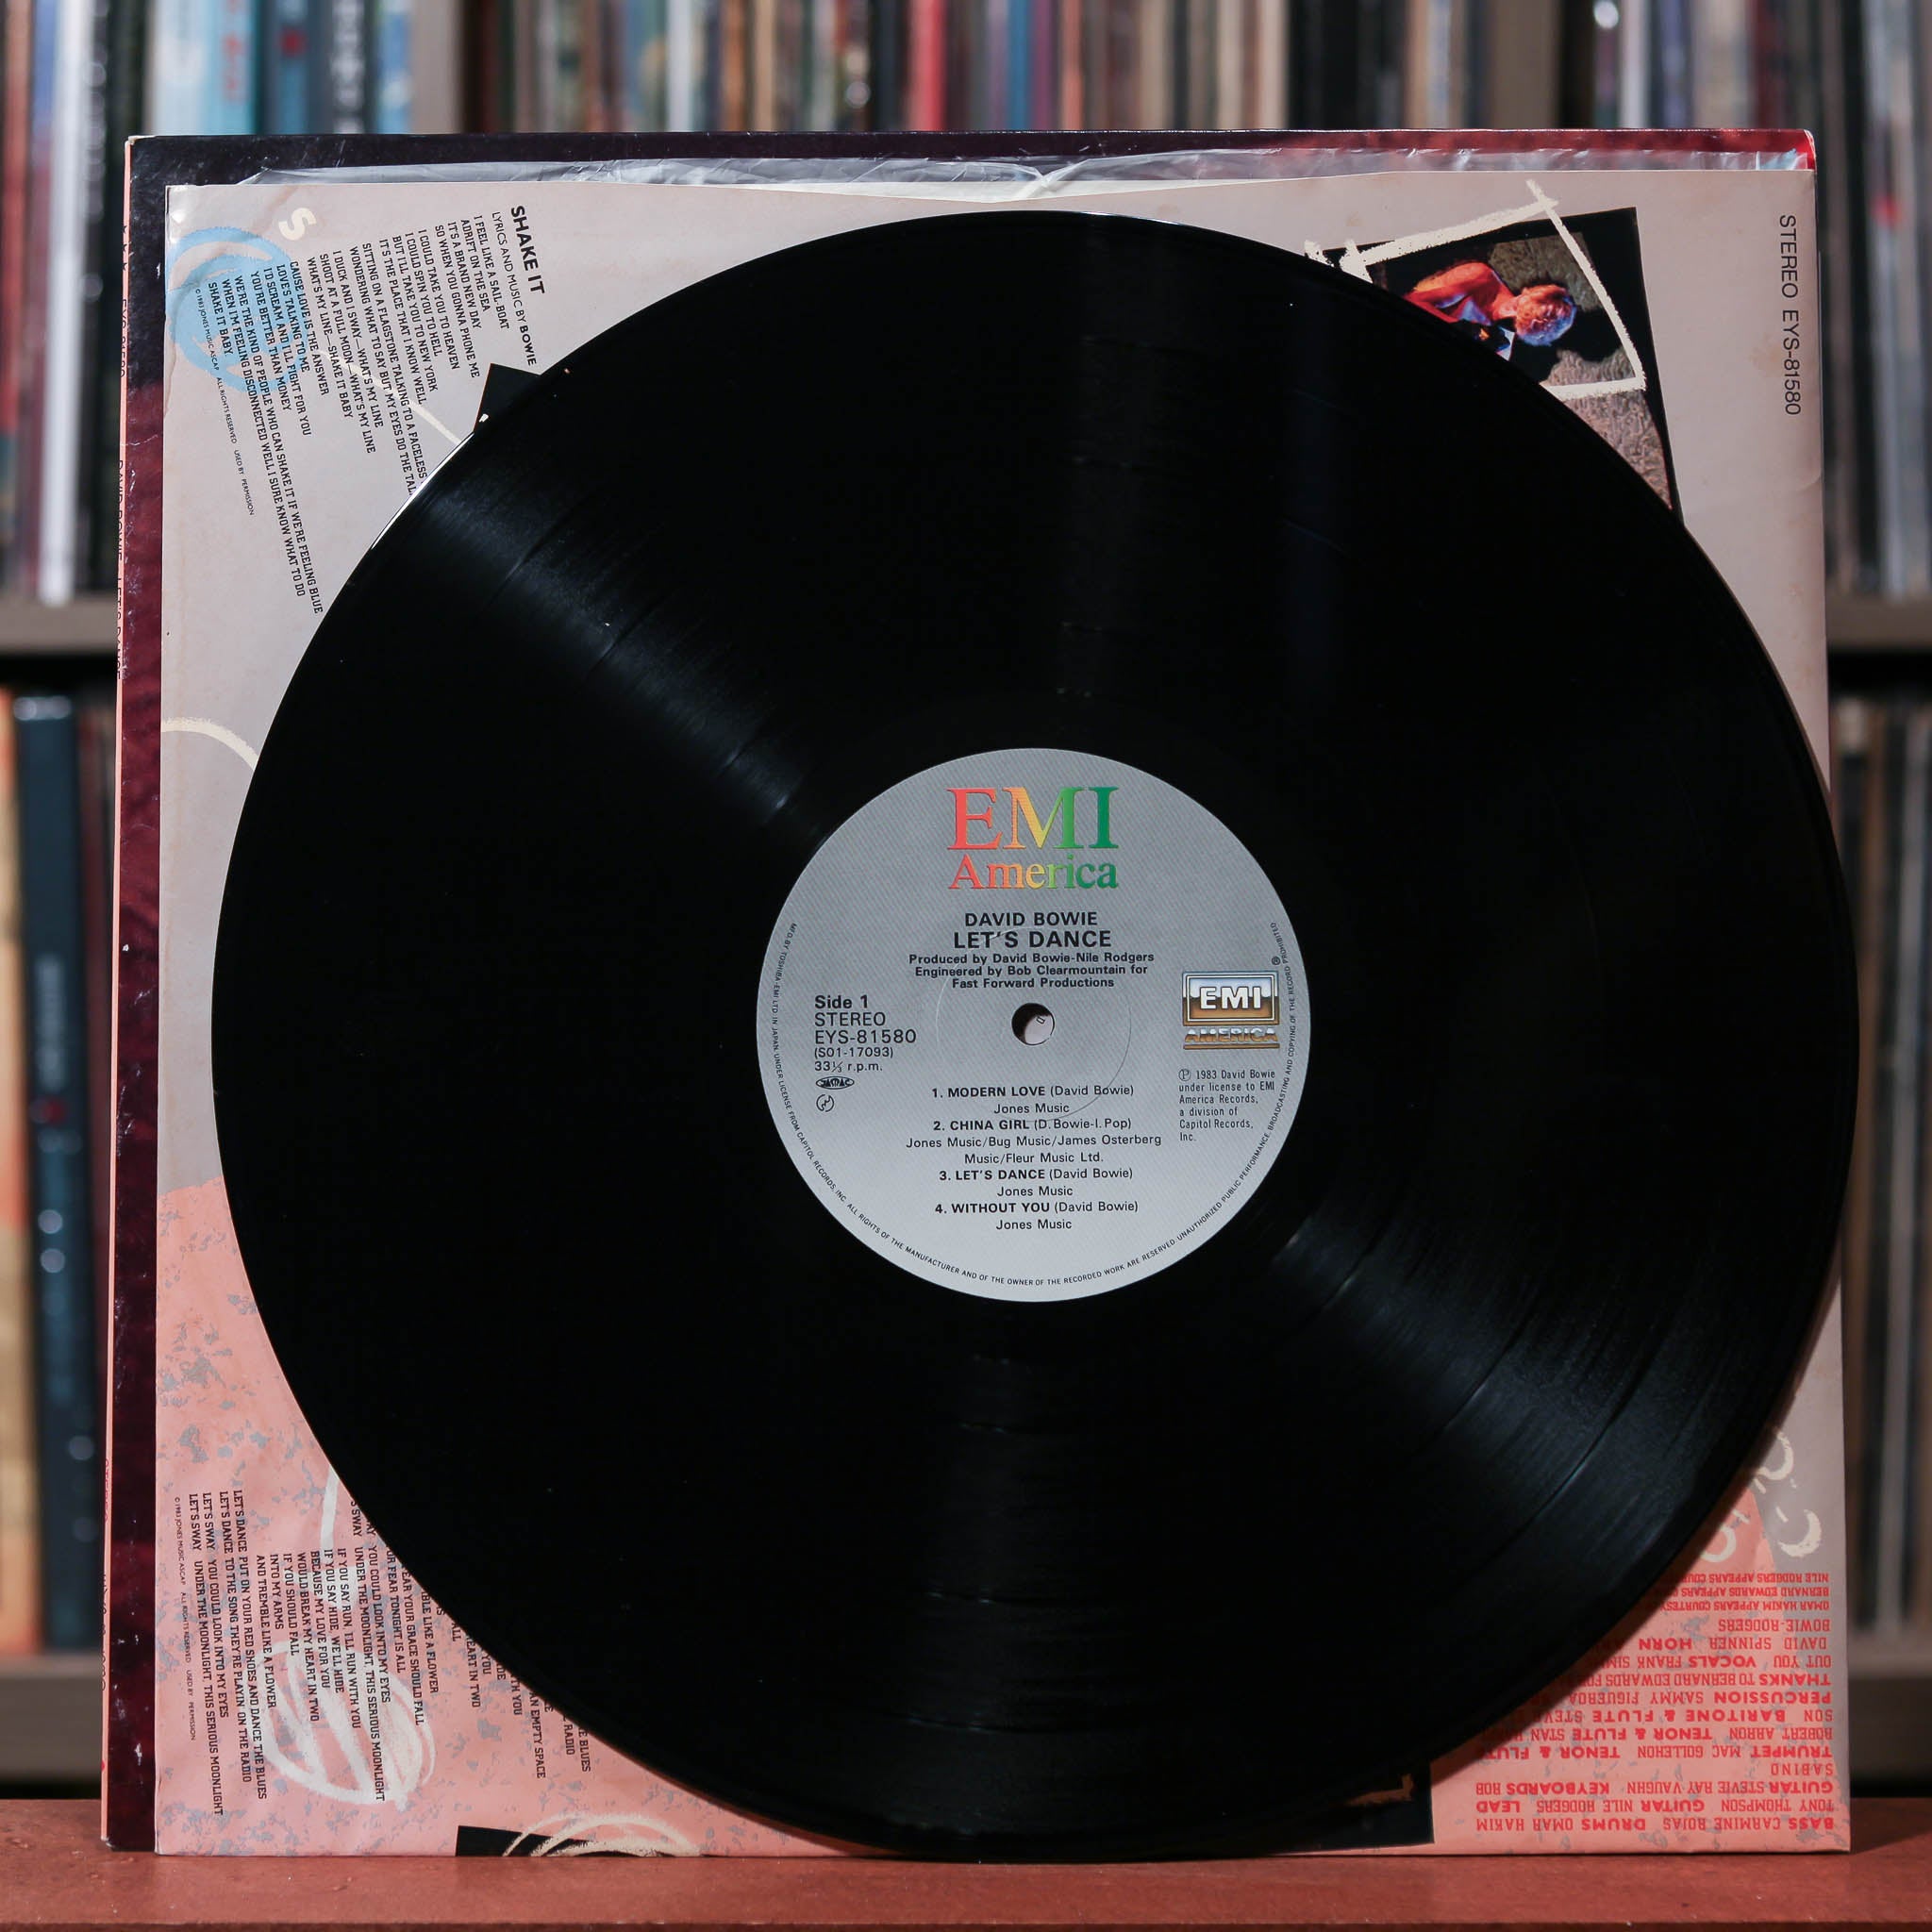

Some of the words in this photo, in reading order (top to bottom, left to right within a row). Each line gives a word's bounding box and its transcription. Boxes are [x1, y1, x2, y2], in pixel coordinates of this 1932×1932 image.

[475, 221, 488, 245] FEEL
[491, 211, 507, 245] LYRICS
[510, 205, 539, 271] SHAKE
[527, 275, 545, 294] IT
[1779, 215, 1797, 297] STEREO
[481, 246, 494, 269] LIKE
[500, 247, 513, 272] AND
[221, 278, 236, 308] WHEN
[507, 274, 522, 308] MUSIC
[489, 279, 509, 328] SAIL-BOAT
[515, 309, 526, 322] BY
[232, 326, 250, 368] FEELING
[519, 325, 536, 366] BOWIE
[258, 307, 275, 345] BETTER
[268, 346, 282, 374] THAN
[275, 375, 291, 409] MONEY
[1782, 309, 1801, 414] EYS-81580
[242, 368, 267, 441] DISCONNECTED
[260, 441, 274, 470] WELL
[268, 477, 283, 504] SURE
[275, 505, 291, 535] KNOW
[284, 537, 298, 565] WHAT
[291, 567, 302, 581] TO
[294, 582, 305, 596] DO
[948, 786, 1118, 850] EMI
[949, 854, 1118, 890] America
[965, 912, 1025, 926] DAVID
[1034, 911, 1097, 925] BOWIE
[954, 931, 1018, 948] LET'S
[1029, 930, 1111, 947] DANCE
[909, 954, 967, 964] Produced
[973, 954, 988, 965] by
[993, 953, 1026, 963] David
[1105, 952, 1154, 965] Rodgers
[915, 966, 983, 978] Engineered
[988, 966, 1002, 977] by
[1008, 965, 1031, 975] Bob
[1037, 964, 1125, 975] Clearmountain
[1130, 964, 1147, 974] for
[953, 978, 978, 989] Fast
[984, 977, 1034, 988] Forward
[1041, 977, 1114, 988] Productions
[815, 995, 852, 1009] Side
[860, 994, 867, 1008] 1
[1200, 987, 1261, 1009] EMI
[815, 1012, 886, 1026] STEREO
[815, 1029, 916, 1044] EYS-81580
[1185, 1027, 1278, 1042] AMERICA
[814, 1046, 893, 1059] (S01-17093)
[848, 1063, 882, 1073] r.p.m.
[1196, 1070, 1217, 1079] 1983
[1222, 1070, 1245, 1079] David
[1250, 1069, 1274, 1078] Bowie
[932, 1089, 942, 1098] 1.
[948, 1087, 1006, 1097] MODERN
[1011, 1086, 1045, 1096] LOVE
[1051, 1086, 1088, 1097] (David
[1094, 1085, 1133, 1096] Bowie)
[1179, 1083, 1205, 1091] under
[1209, 1082, 1241, 1091] license
[1246, 1082, 1255, 1091] to
[1260, 1081, 1274, 1091] EMI
[1179, 1094, 1214, 1104] America
[1219, 1093, 1258, 1104] Records,
[993, 1104, 1029, 1114] Jones
[1035, 1103, 1069, 1113] Music
[1190, 1108, 1224, 1116] division
[1229, 1107, 1238, 1116] of
[933, 1121, 944, 1131] 2.
[950, 1120, 993, 1130] CHINA
[999, 1120, 1029, 1130] GIRL
[1180, 1119, 1211, 1130] Capitol
[1214, 1119, 1253, 1128] Records,
[906, 1138, 941, 1148] Jones
[1102, 1134, 1161, 1146] Osterberg
[1180, 1132, 1196, 1141] Inc.
[1041, 1153, 1074, 1162] Music
[1081, 1152, 1103, 1162] Ltd.
[940, 1171, 951, 1180] 3.
[956, 1170, 992, 1180] LET'S
[998, 1169, 1045, 1179] DANCE
[1049, 1169, 1087, 1180] (David
[1093, 1168, 1132, 1179] Bowie)
[997, 1187, 1033, 1196] Jones
[1039, 1186, 1073, 1195] Music
[935, 1204, 946, 1213] 4.
[951, 1203, 1016, 1213] WITHOUT
[1022, 1203, 1049, 1212] YOU
[1055, 1202, 1092, 1214] (David
[1098, 1201, 1138, 1212] Bowie)
[996, 1220, 1032, 1230] Jones
[1038, 1219, 1072, 1229] Music
[191, 1523, 201, 1550] SWAY
[235, 1519, 247, 1552] DANCE
[256, 1555, 266, 1576] AND
[193, 1560, 205, 1596] UNDER
[196, 1597, 208, 1619] THE
[258, 1578, 270, 1628] TREMBLE
[1718, 1618, 1829, 1632] BOWIE-RODGERS
[260, 1629, 272, 1654] LIKE
[1638, 1637, 1691, 1650] HORN
[1784, 1636, 1826, 1649] DAVID
[264, 1665, 276, 1708] FLOWER
[203, 1684, 214, 1708] THIS
[1650, 1690, 1703, 1704] SAMMY
[1713, 1690, 1830, 1704] PERCUSSION
[205, 1710, 218, 1753] SERIOUS
[1712, 1744, 1740, 1757] MAC
[1750, 1744, 1832, 1757] TRUMPET
[1771, 1762, 1833, 1775] SABINO
[209, 1756, 223, 1815] MOONLIGHT
[1641, 1798, 1704, 1811] GUITAR
[1721, 1798, 1791, 1811] THOMPSON
[1798, 1798, 1834, 1811] TONY
[1476, 1818, 1524, 1830] HAKIM
[1532, 1817, 1573, 1831] OMAR
[1581, 1817, 1645, 1830] DRUMS
[1713, 1816, 1780, 1830] CARMINE
[1788, 1816, 1833, 1829] BASS
